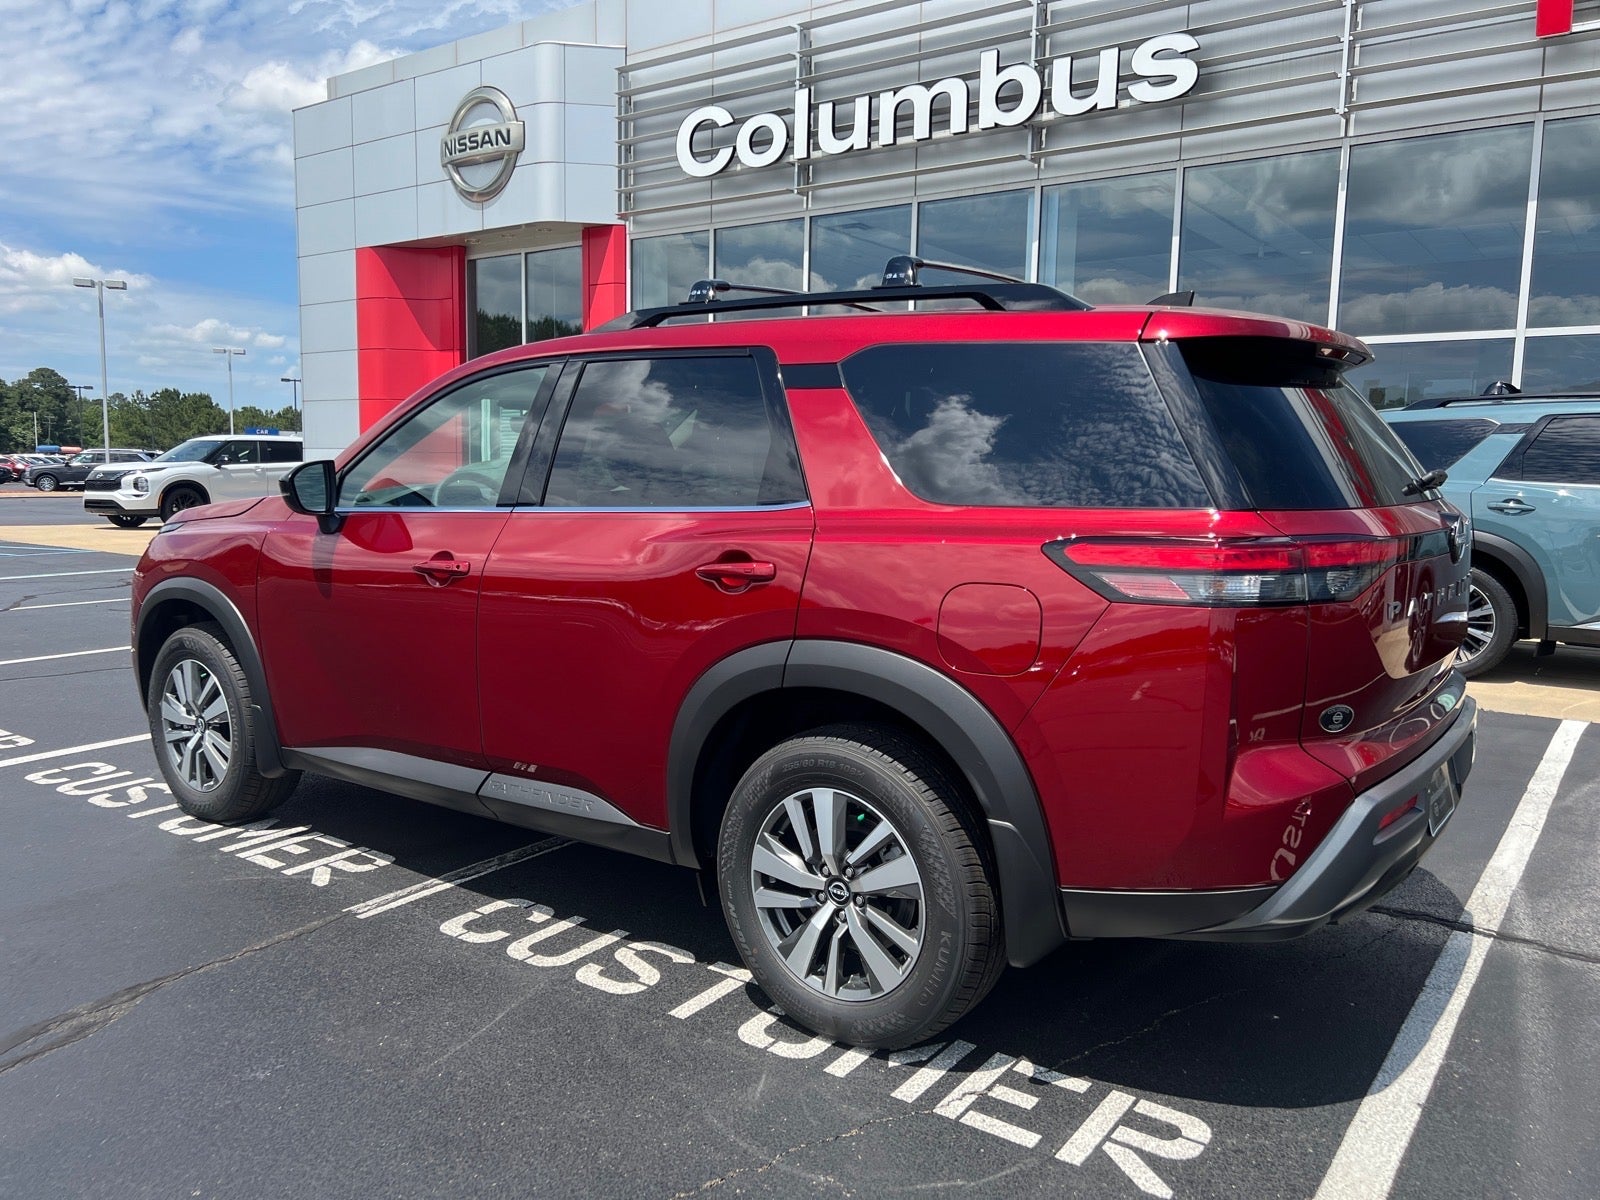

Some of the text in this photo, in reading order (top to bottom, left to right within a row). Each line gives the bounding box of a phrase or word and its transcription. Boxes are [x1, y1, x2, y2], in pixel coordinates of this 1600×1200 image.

[675, 32, 1200, 178] Columbus
[443, 127, 511, 158] NISSAN
[488, 779, 596, 813] PATHFINDER
